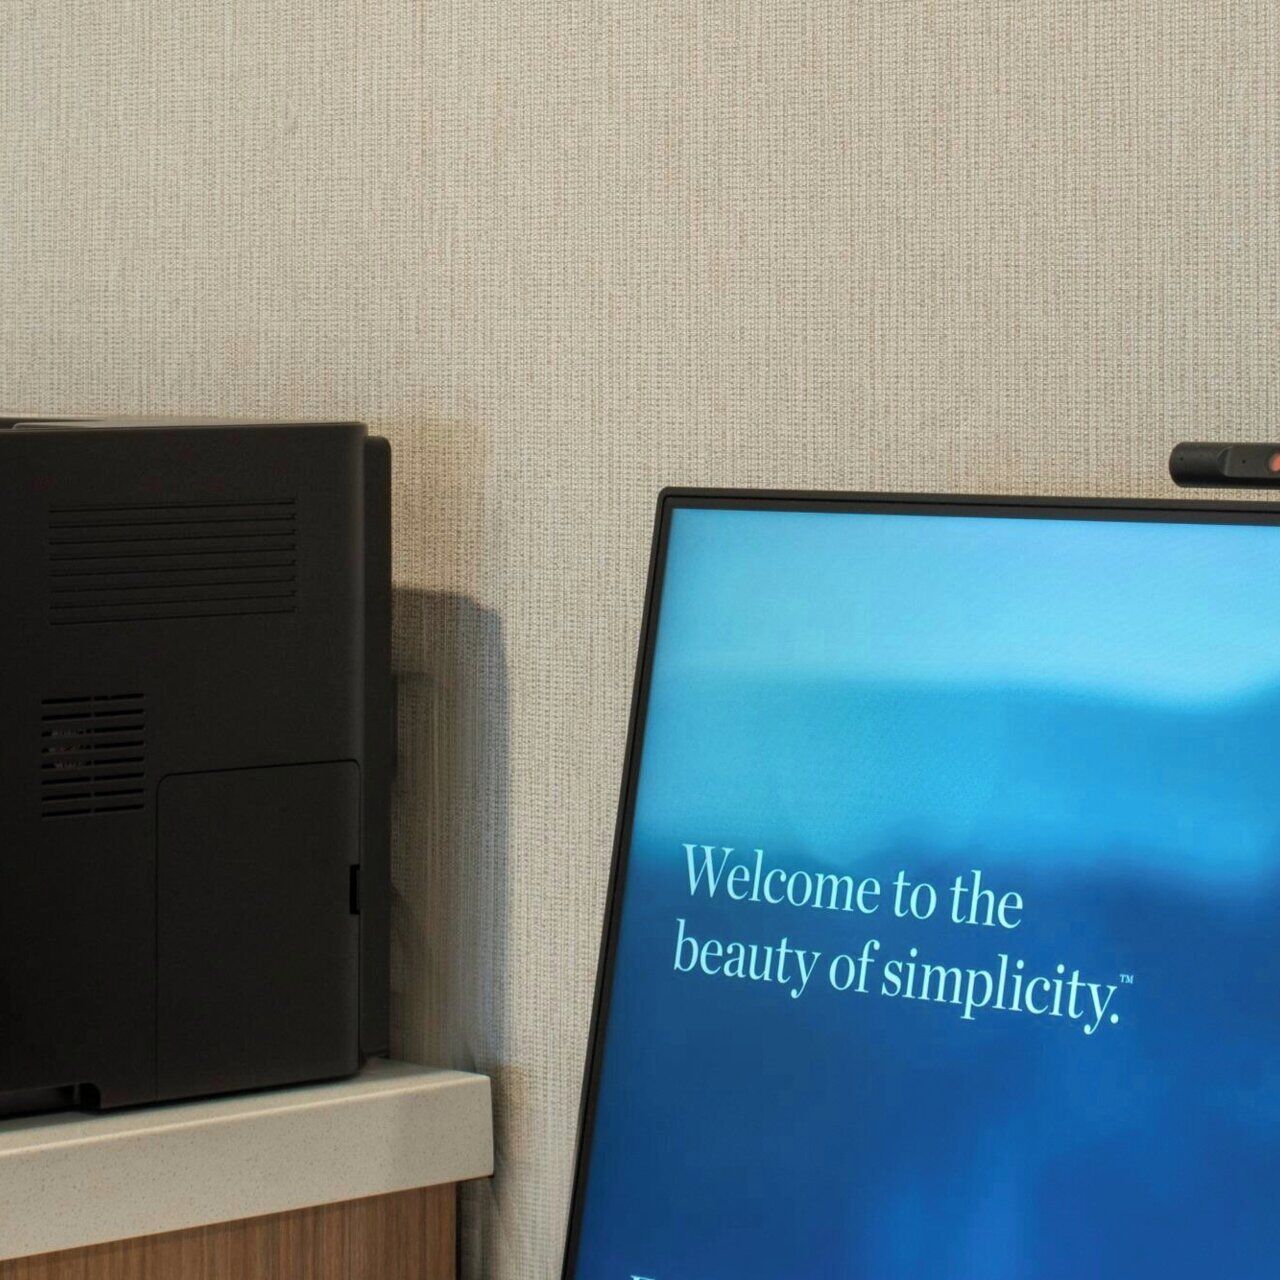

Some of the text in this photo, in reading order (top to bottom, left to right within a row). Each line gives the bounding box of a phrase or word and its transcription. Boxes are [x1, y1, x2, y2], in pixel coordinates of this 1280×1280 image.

[681, 843, 1022, 928] Welcome to the
[674, 919, 821, 998] beauty
[830, 940, 880, 992] of
